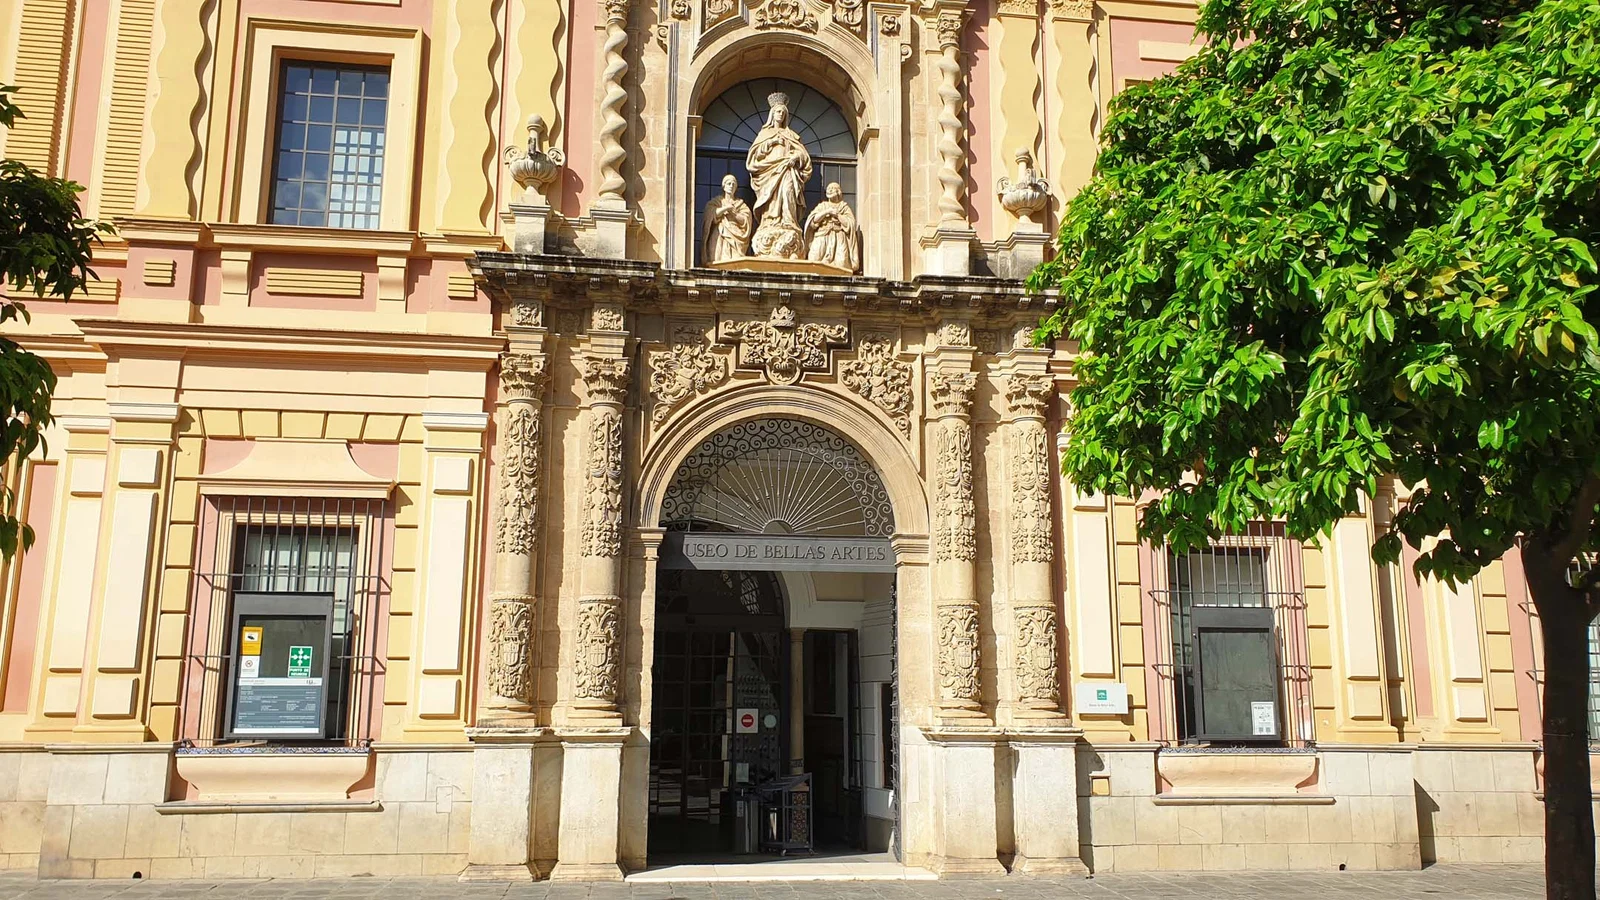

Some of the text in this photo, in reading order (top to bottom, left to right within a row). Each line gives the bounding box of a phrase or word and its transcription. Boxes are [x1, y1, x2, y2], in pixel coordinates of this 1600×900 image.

[684, 543, 886, 561] USEO DE BELLAS ARTES
